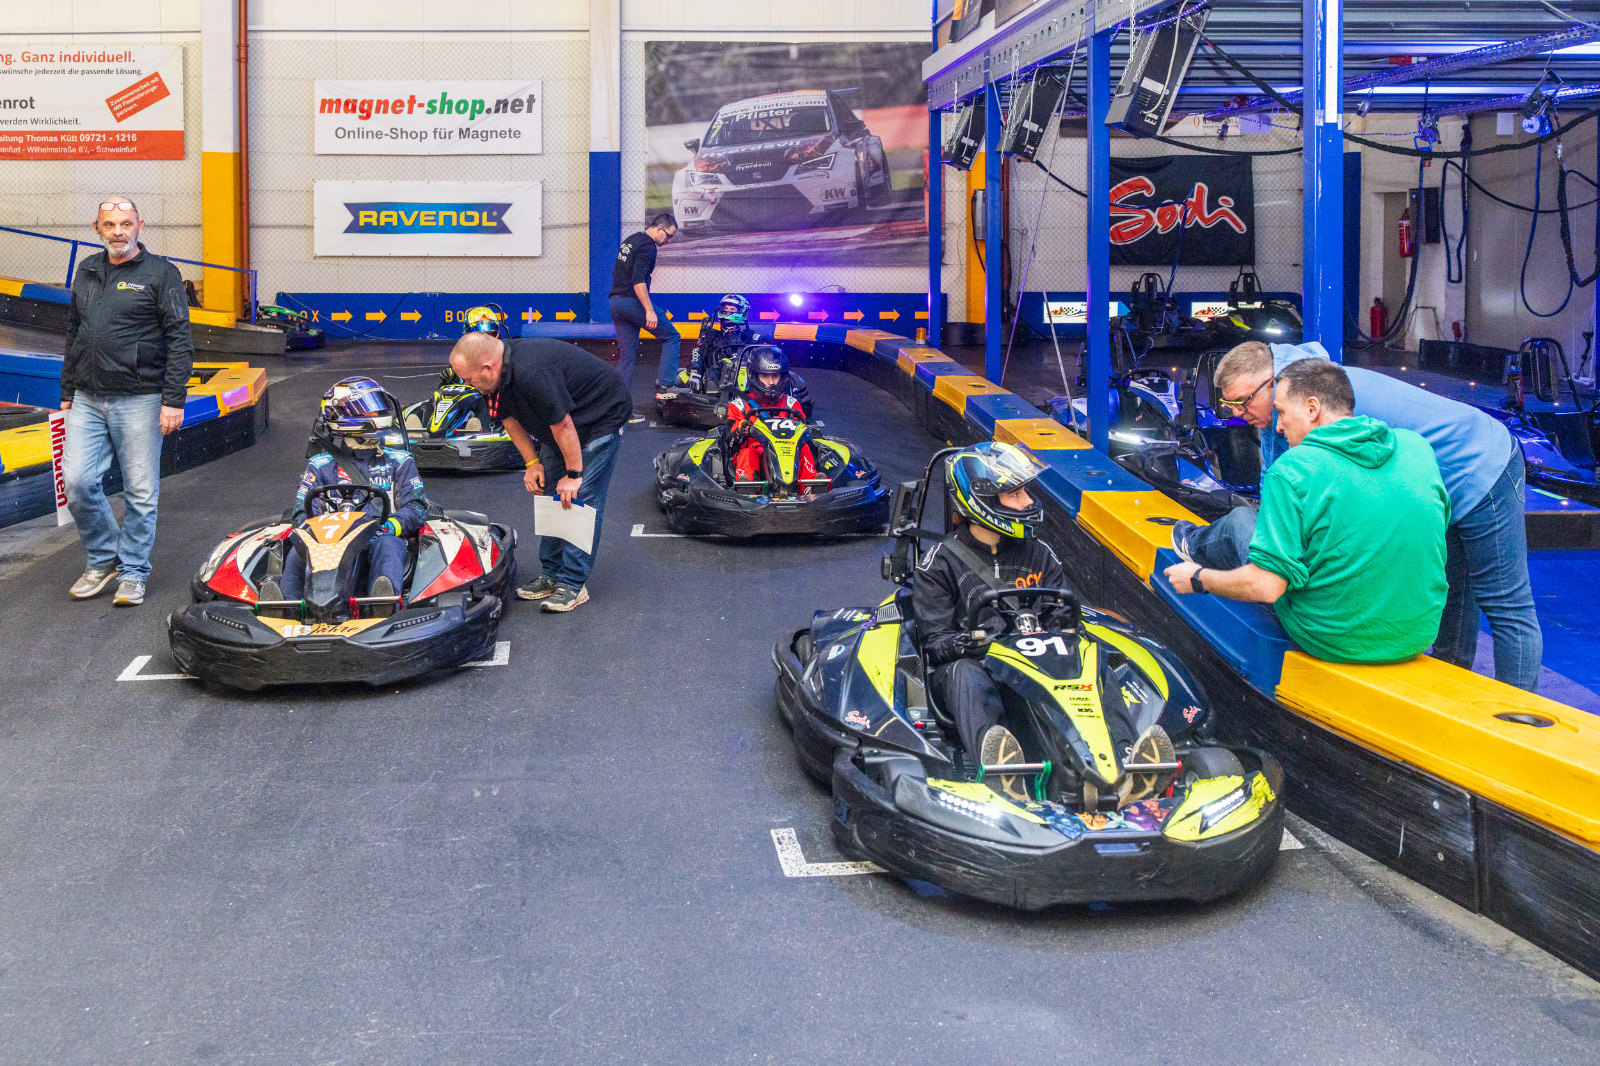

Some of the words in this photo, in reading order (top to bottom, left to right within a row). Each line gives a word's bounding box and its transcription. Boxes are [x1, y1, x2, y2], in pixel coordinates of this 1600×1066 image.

[21, 51, 55, 63] Ganz
[59, 51, 136, 63] individuell.
[34, 67, 66, 76] jederzeit
[68, 67, 80, 75] die
[81, 68, 114, 76] passende
[116, 67, 144, 76] Lösung.
[319, 92, 536, 121] magnet-shop.net
[30, 117, 81, 126] Wirklichkeit.
[735, 108, 793, 122] Pfister
[26, 134, 58, 142] Thomas
[60, 134, 78, 142] Kütt
[79, 134, 106, 142] 09721
[115, 134, 137, 142] 1216
[334, 127, 428, 142] Online-Shop
[432, 127, 453, 140] für
[458, 127, 522, 142] Magnete
[825, 187, 847, 200] KW
[684, 206, 699, 215] KW
[1110, 176, 1247, 245] Sodi
[288, 309, 320, 323] OX
[765, 419, 797, 430] 74
[50, 417, 69, 508] Minuten
[322, 524, 341, 539] 7
[1015, 636, 1069, 657] 91
[1053, 683, 1093, 691] RSX
[845, 711, 870, 729] Sodi
